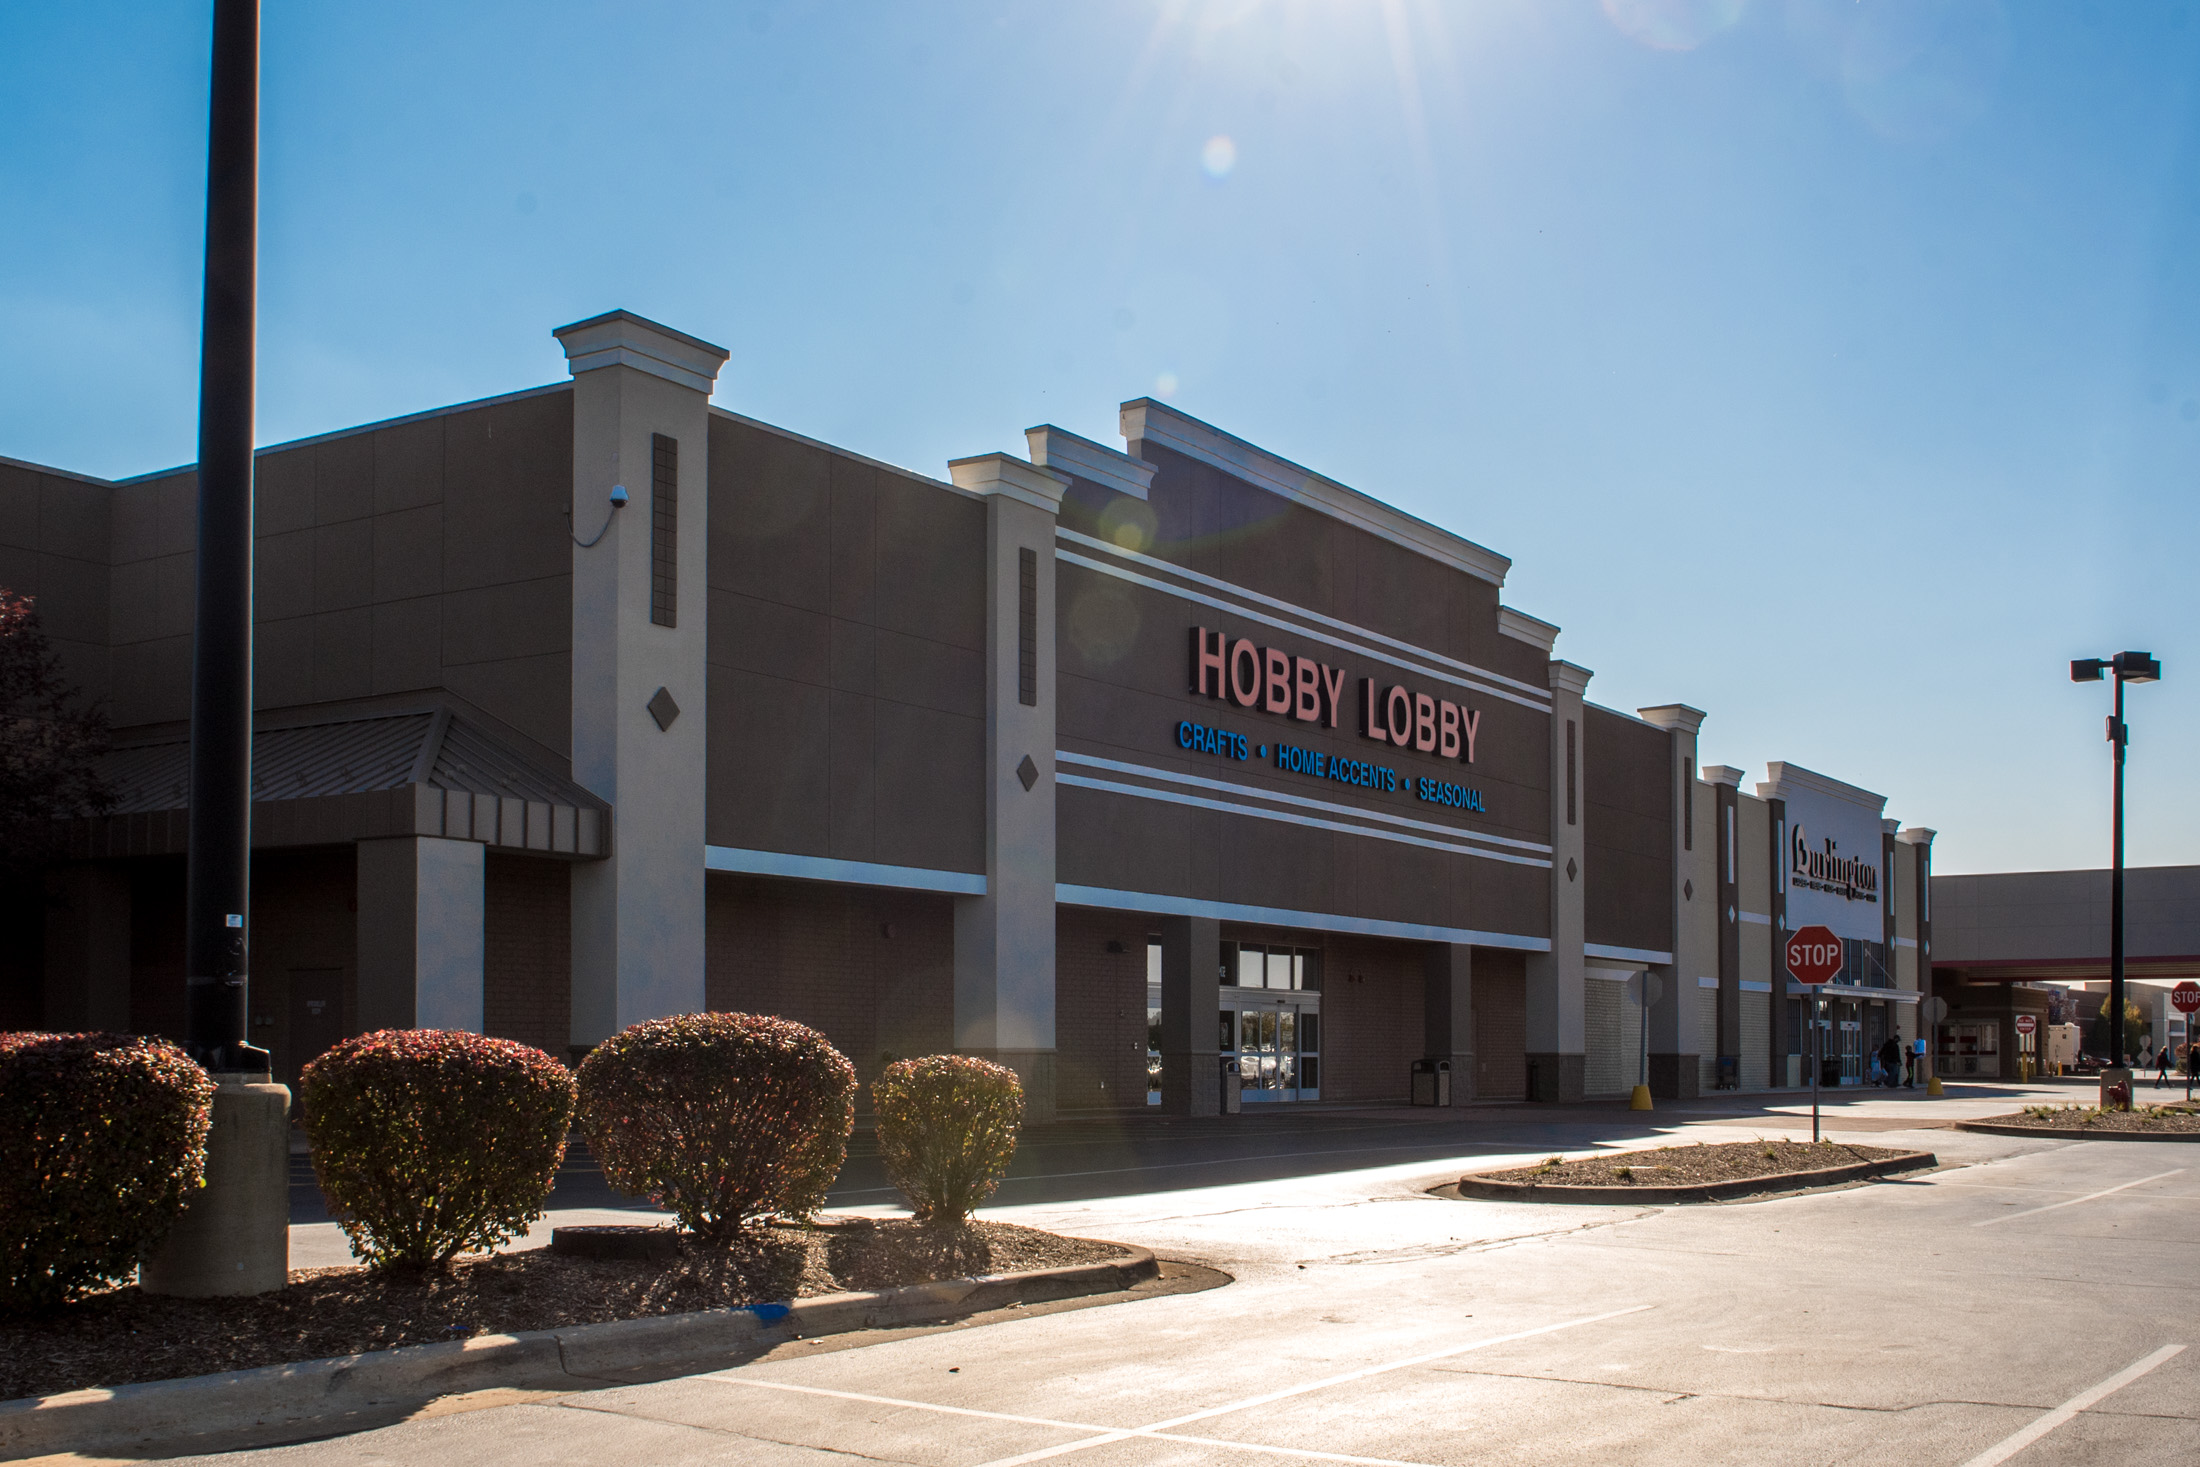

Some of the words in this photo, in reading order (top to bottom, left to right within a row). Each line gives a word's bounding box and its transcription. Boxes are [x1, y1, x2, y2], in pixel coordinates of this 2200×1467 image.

[1189, 626, 1345, 728] HOBBY
[1358, 677, 1480, 763] LOBBY
[1175, 720, 1248, 760] CRAFTS
[1274, 743, 1325, 777] HOME
[1326, 755, 1396, 792] ACCENTS
[1416, 776, 1486, 812] SEASONAL
[1791, 823, 1878, 901] Burlington
[1789, 944, 1839, 966] STOP
